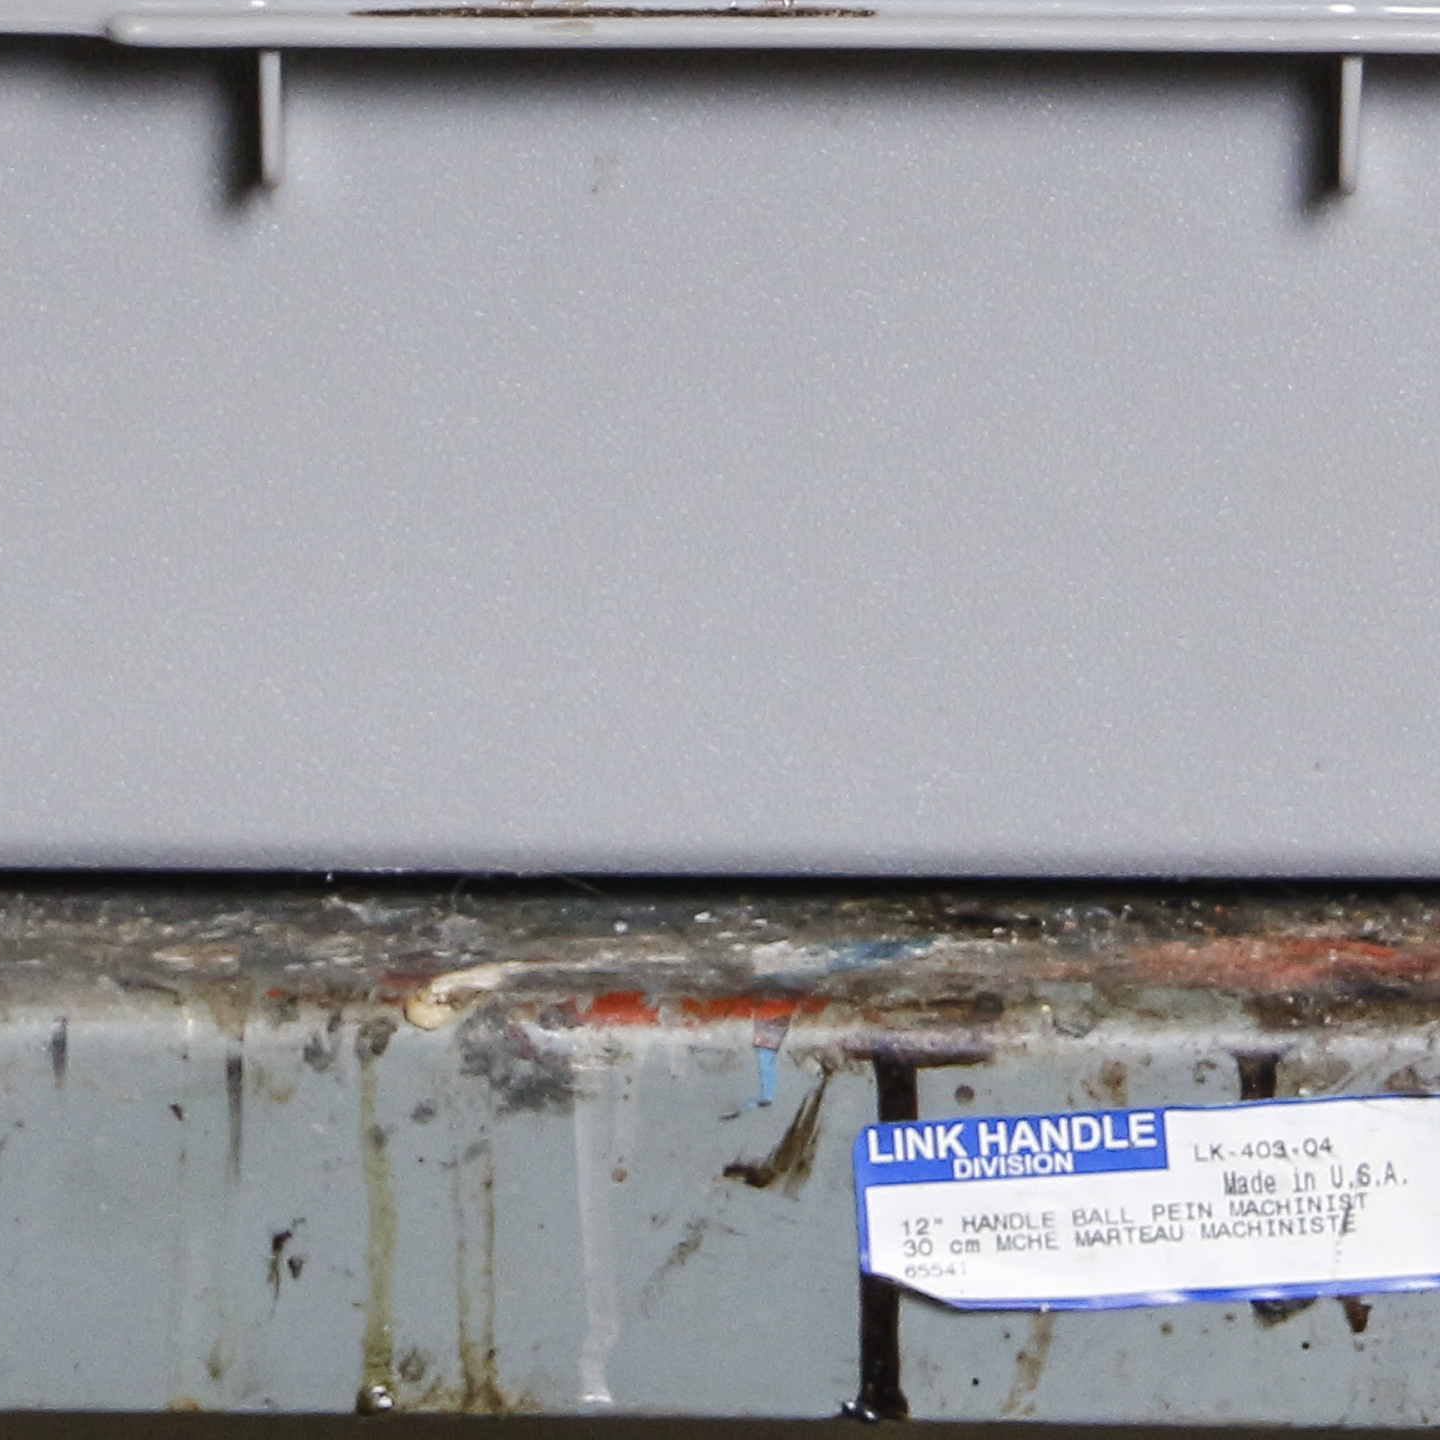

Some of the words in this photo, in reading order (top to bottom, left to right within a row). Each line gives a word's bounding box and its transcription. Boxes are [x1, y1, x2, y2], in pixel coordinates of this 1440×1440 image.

[867, 1123, 967, 1164] LINK
[977, 1112, 1158, 1156] HANDLE
[953, 1151, 1075, 1180] DIVISION
[1223, 1169, 1276, 1196] Made
[1292, 1167, 1316, 1192] in
[1330, 1160, 1409, 1189] U.S.A.
[902, 1217, 943, 1236] 12"
[961, 1210, 1056, 1234] HANDLE
[1071, 1206, 1135, 1227] BALL
[1152, 1201, 1213, 1221] PEIN
[1229, 1191, 1369, 1218] MACHINIST
[903, 1237, 933, 1258] 30
[949, 1238, 981, 1254] cm
[996, 1230, 1060, 1252] MCHE
[1074, 1222, 1184, 1247] MARTEAU
[1201, 1213, 1357, 1239] MACHINISTE
